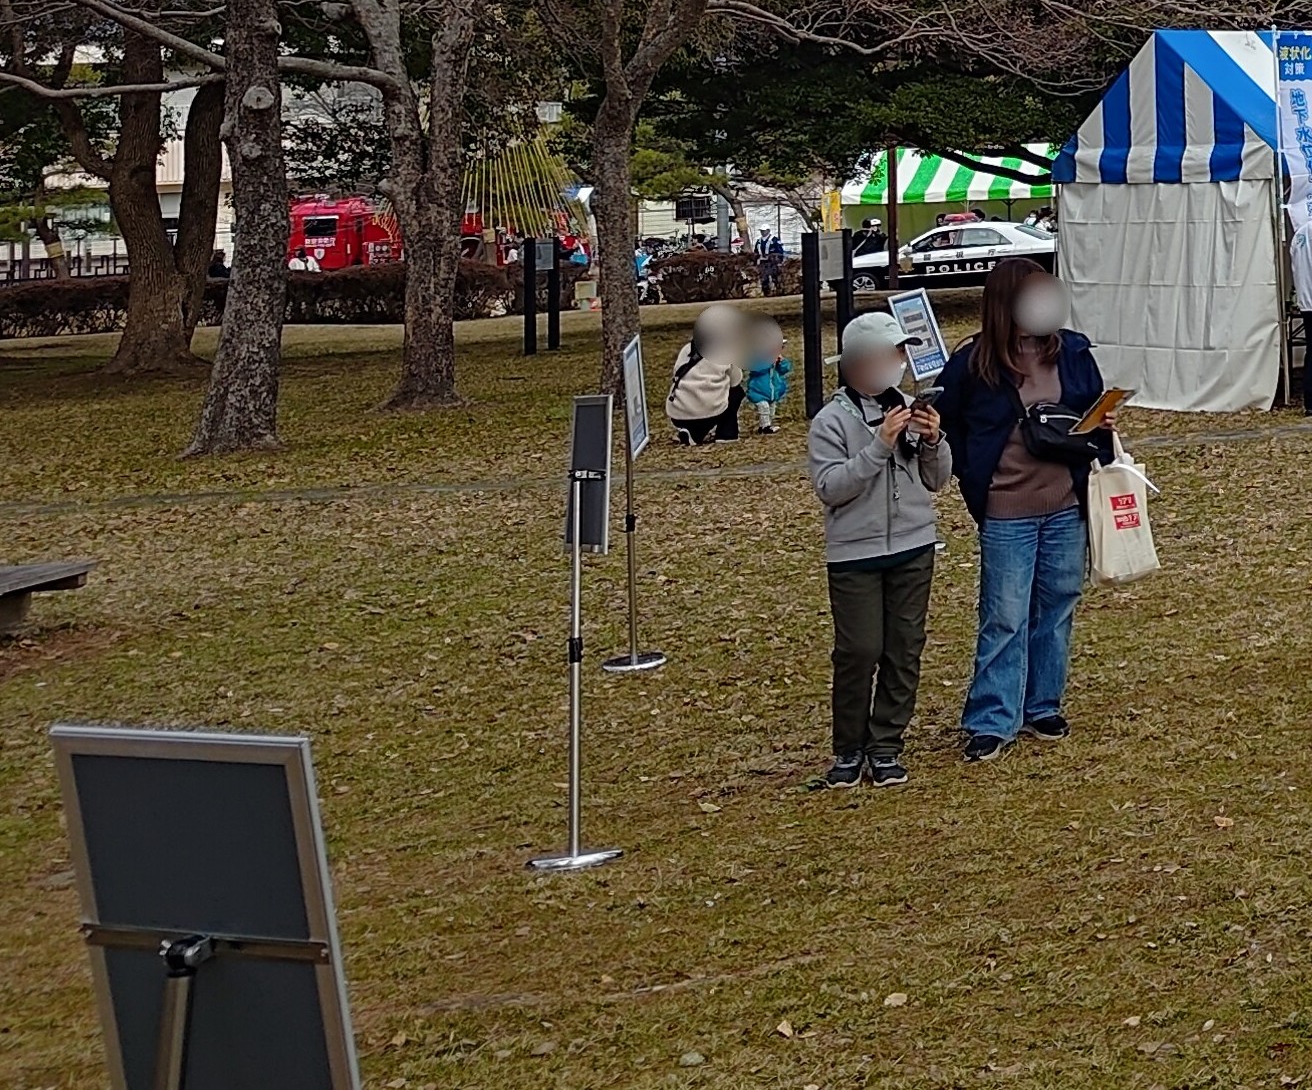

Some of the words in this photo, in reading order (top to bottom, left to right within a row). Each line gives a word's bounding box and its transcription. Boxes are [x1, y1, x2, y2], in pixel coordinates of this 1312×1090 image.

[1279, 45, 1312, 61] 液状化
[1284, 61, 1305, 75] 対策
[925, 260, 997, 274] POLICE
